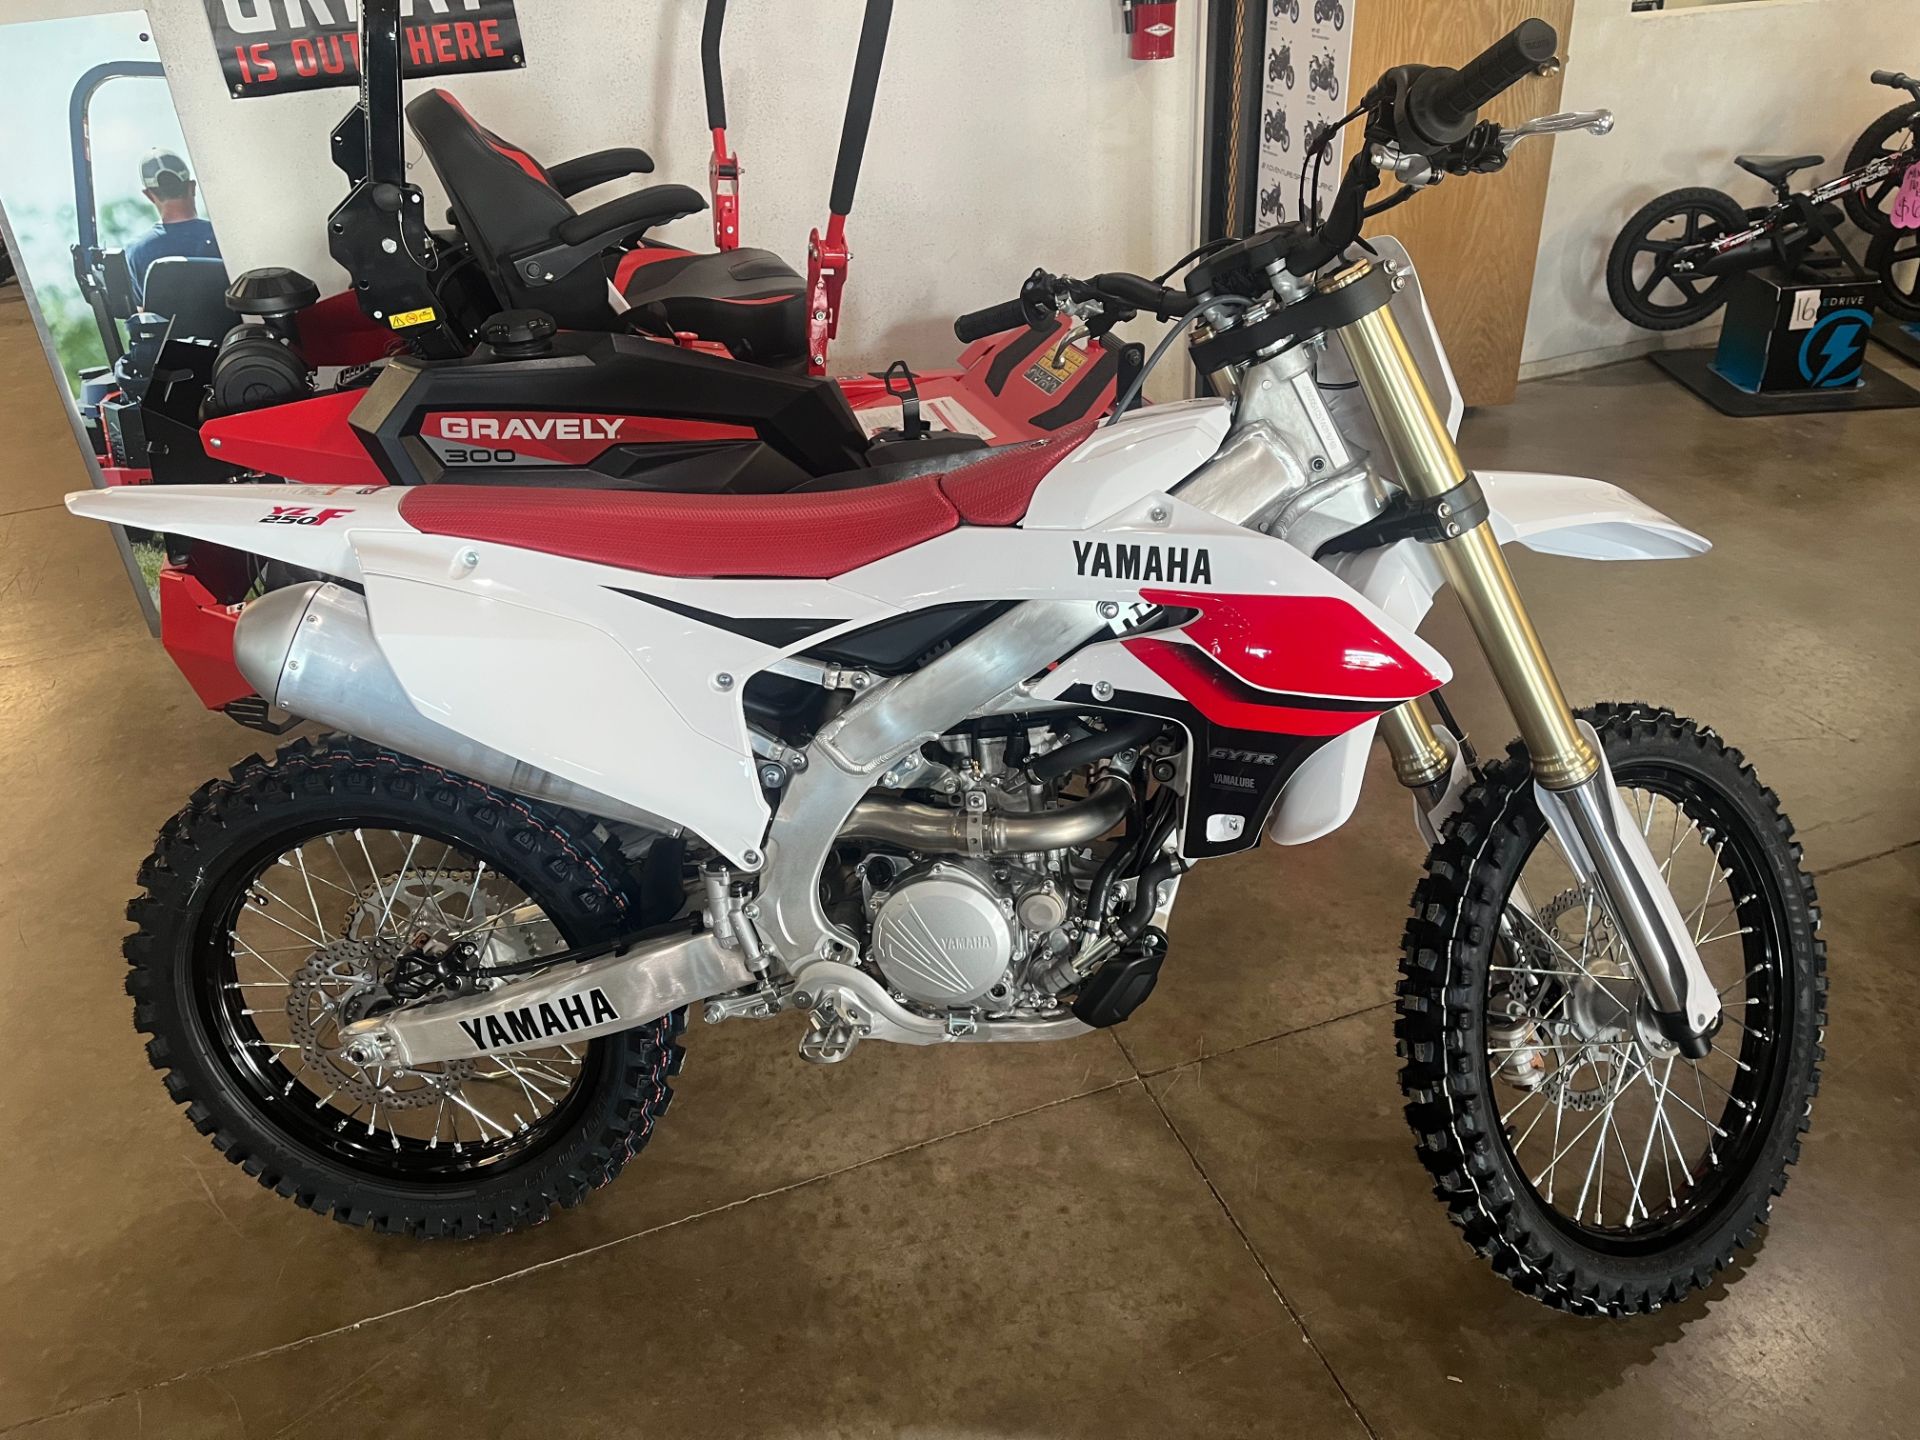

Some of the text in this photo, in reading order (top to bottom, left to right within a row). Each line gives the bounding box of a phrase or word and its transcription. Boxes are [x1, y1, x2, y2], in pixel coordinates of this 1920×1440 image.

[235, 42, 278, 83] IS
[405, 19, 504, 65] HERE
[1796, 297, 1816, 321] 16
[440, 417, 626, 440] GRAVELY
[445, 449, 516, 463] 300
[1072, 540, 1212, 585] YAMAHA
[1208, 747, 1279, 766] GYTR
[1213, 772, 1256, 789] YAMALUBE
[941, 935, 992, 951] YAMAHA
[459, 989, 619, 1050] YAMAHA
